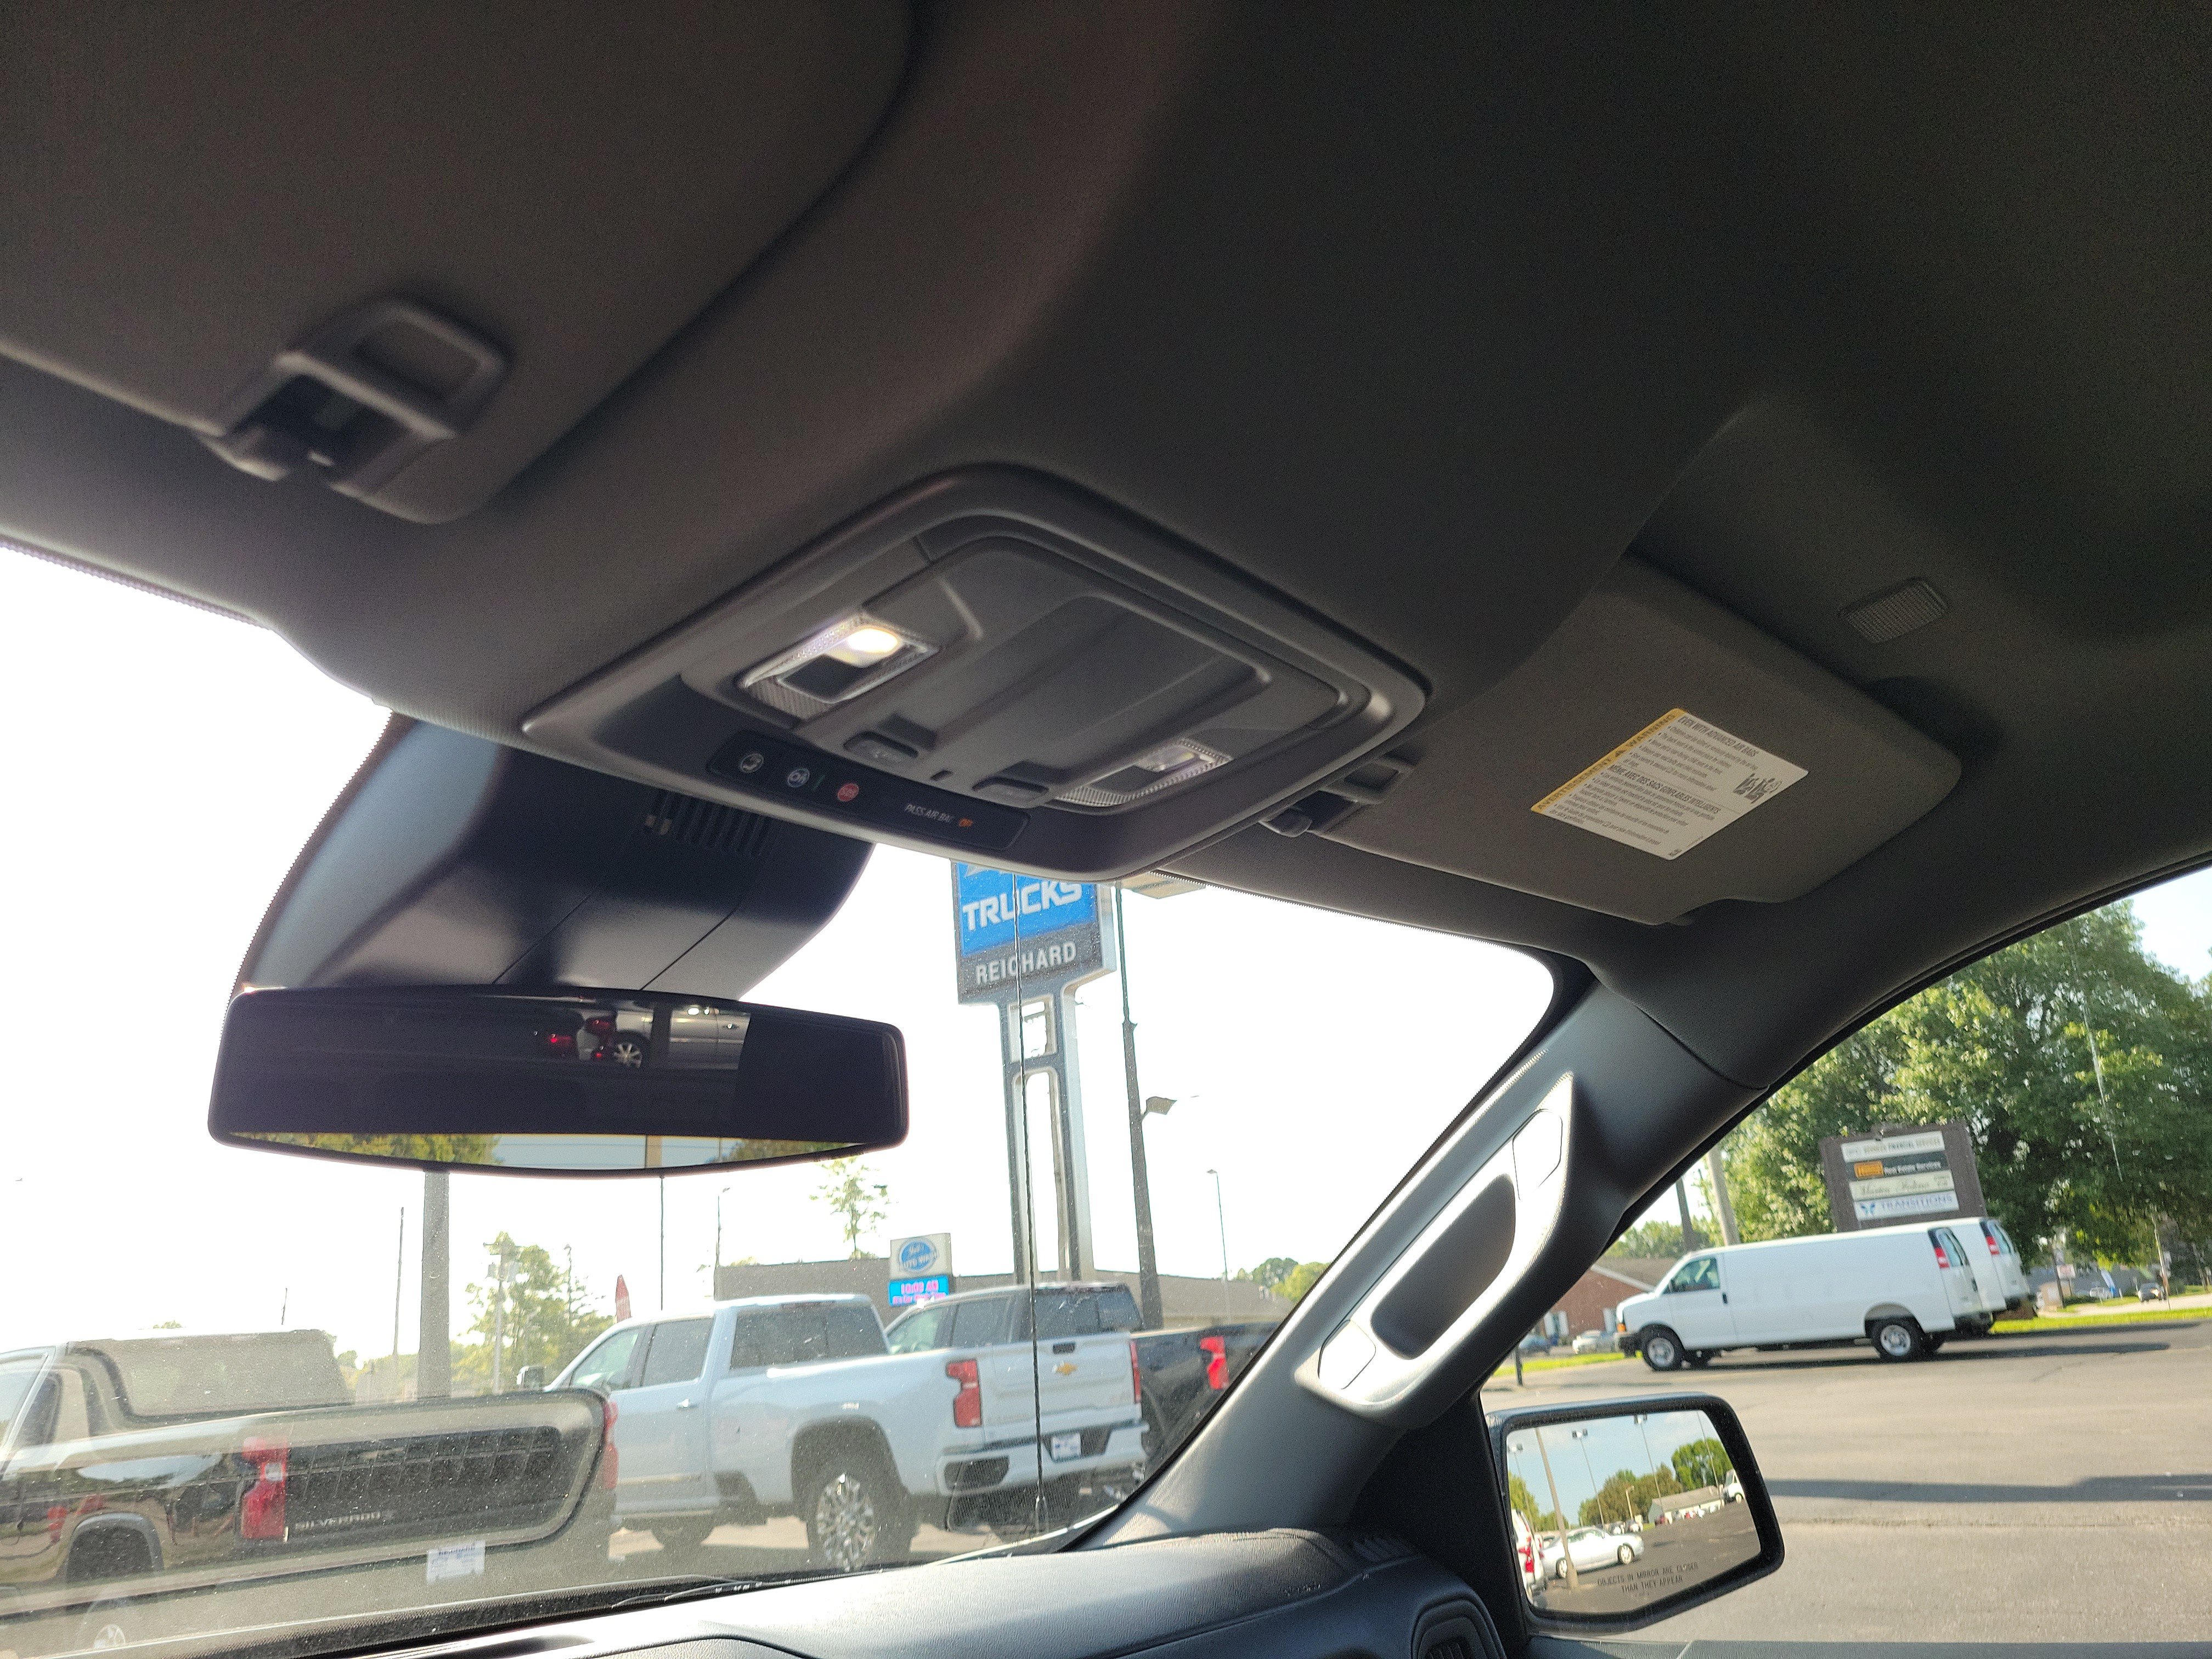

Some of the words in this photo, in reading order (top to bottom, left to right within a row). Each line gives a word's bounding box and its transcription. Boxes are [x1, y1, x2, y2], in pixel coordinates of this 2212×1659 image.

[1677, 715, 1697, 727] EVEN
[1690, 723, 1711, 733] WITH
[905, 804, 926, 816] PASS
[925, 809, 940, 820] AIR
[962, 880, 1082, 931] TRUCKS
[975, 941, 1076, 985] REICHARD
[1881, 1195, 1953, 1210] TRANSITIONS
[1598, 1575, 1624, 1586] OBJECTS
[1637, 1568, 1659, 1579] MIRROR
[1662, 1566, 1673, 1575] ARE
[1677, 1562, 1698, 1572] CLOSER
[1622, 1582, 1638, 1593] THAN
[1641, 1579, 1656, 1590] THEY
[1660, 1575, 1683, 1587] APPEAR
